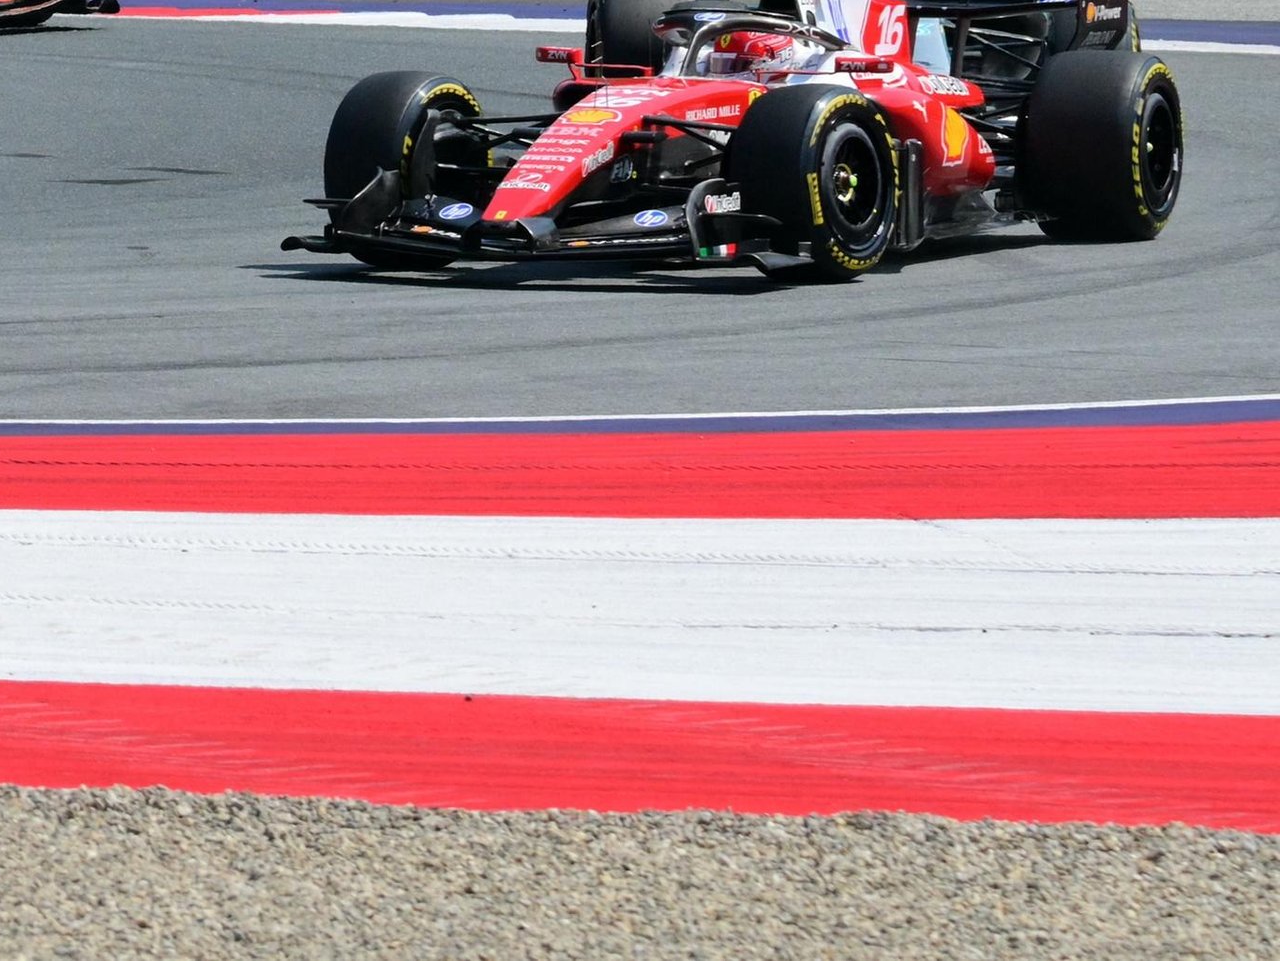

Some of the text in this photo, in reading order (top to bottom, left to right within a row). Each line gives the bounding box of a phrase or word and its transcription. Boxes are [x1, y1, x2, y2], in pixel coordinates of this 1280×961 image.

[876, 4, 907, 56] 16
[547, 50, 568, 60] ZYN
[841, 60, 866, 70] ZYN
[685, 104, 741, 121] RICHARD MILLE
